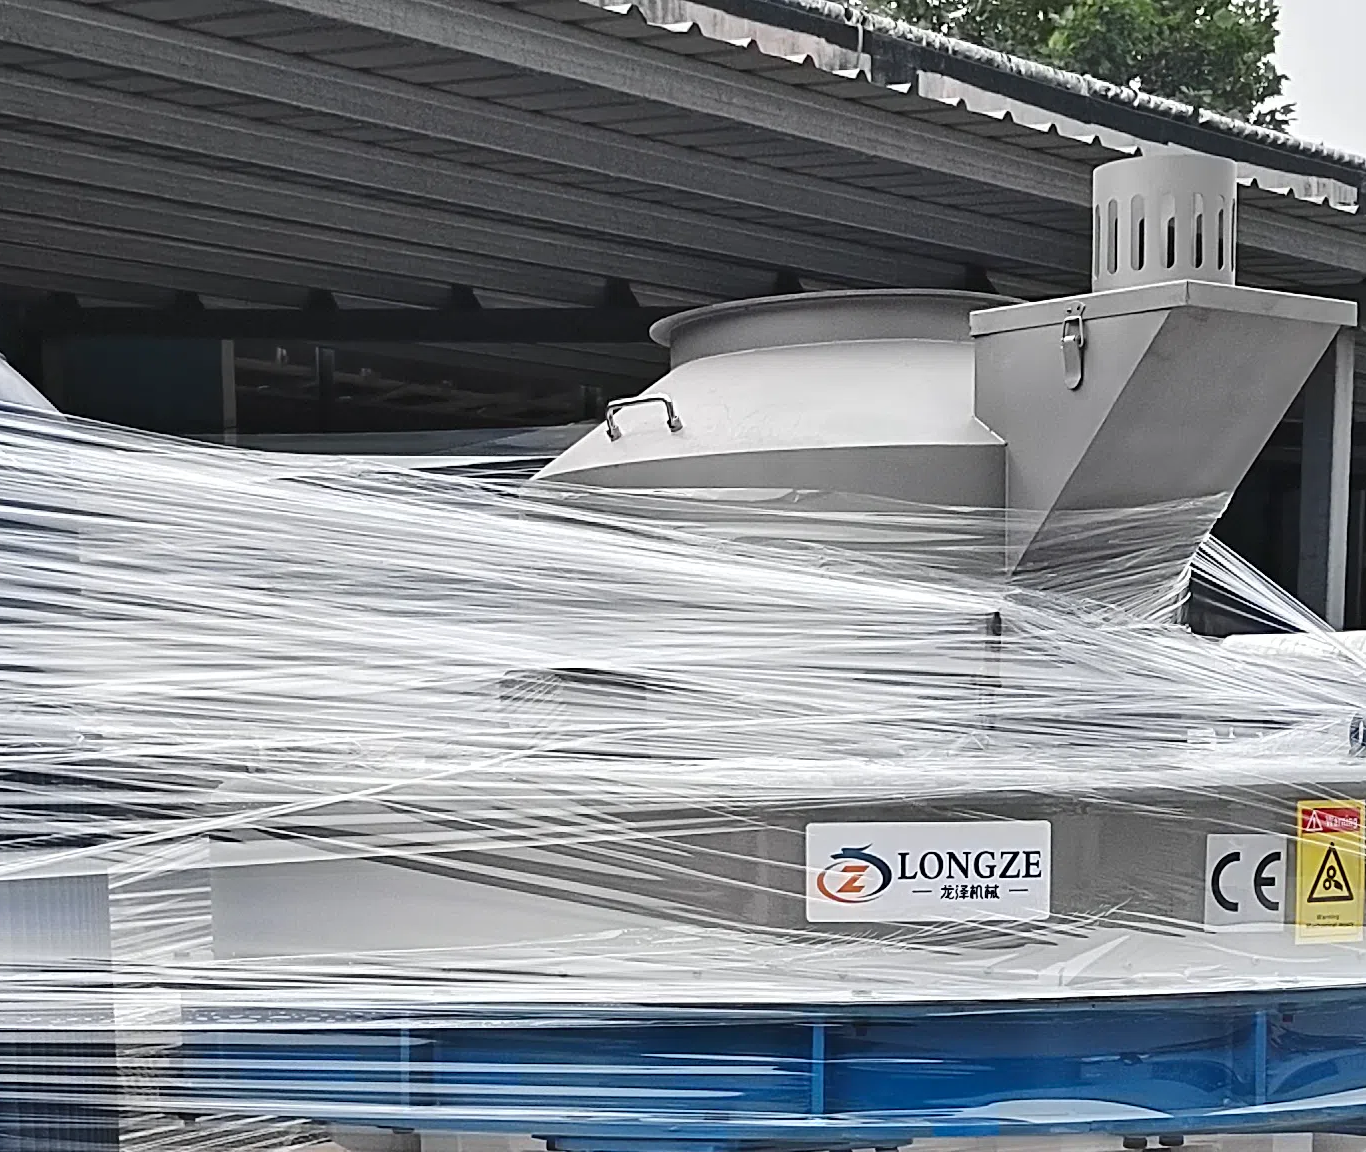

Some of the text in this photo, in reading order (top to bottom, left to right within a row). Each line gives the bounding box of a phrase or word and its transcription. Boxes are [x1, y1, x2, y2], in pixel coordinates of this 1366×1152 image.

[897, 850, 1042, 880] LONGZE
[940, 884, 1000, 900] 龙泽机械
[1211, 851, 1282, 912] CE
